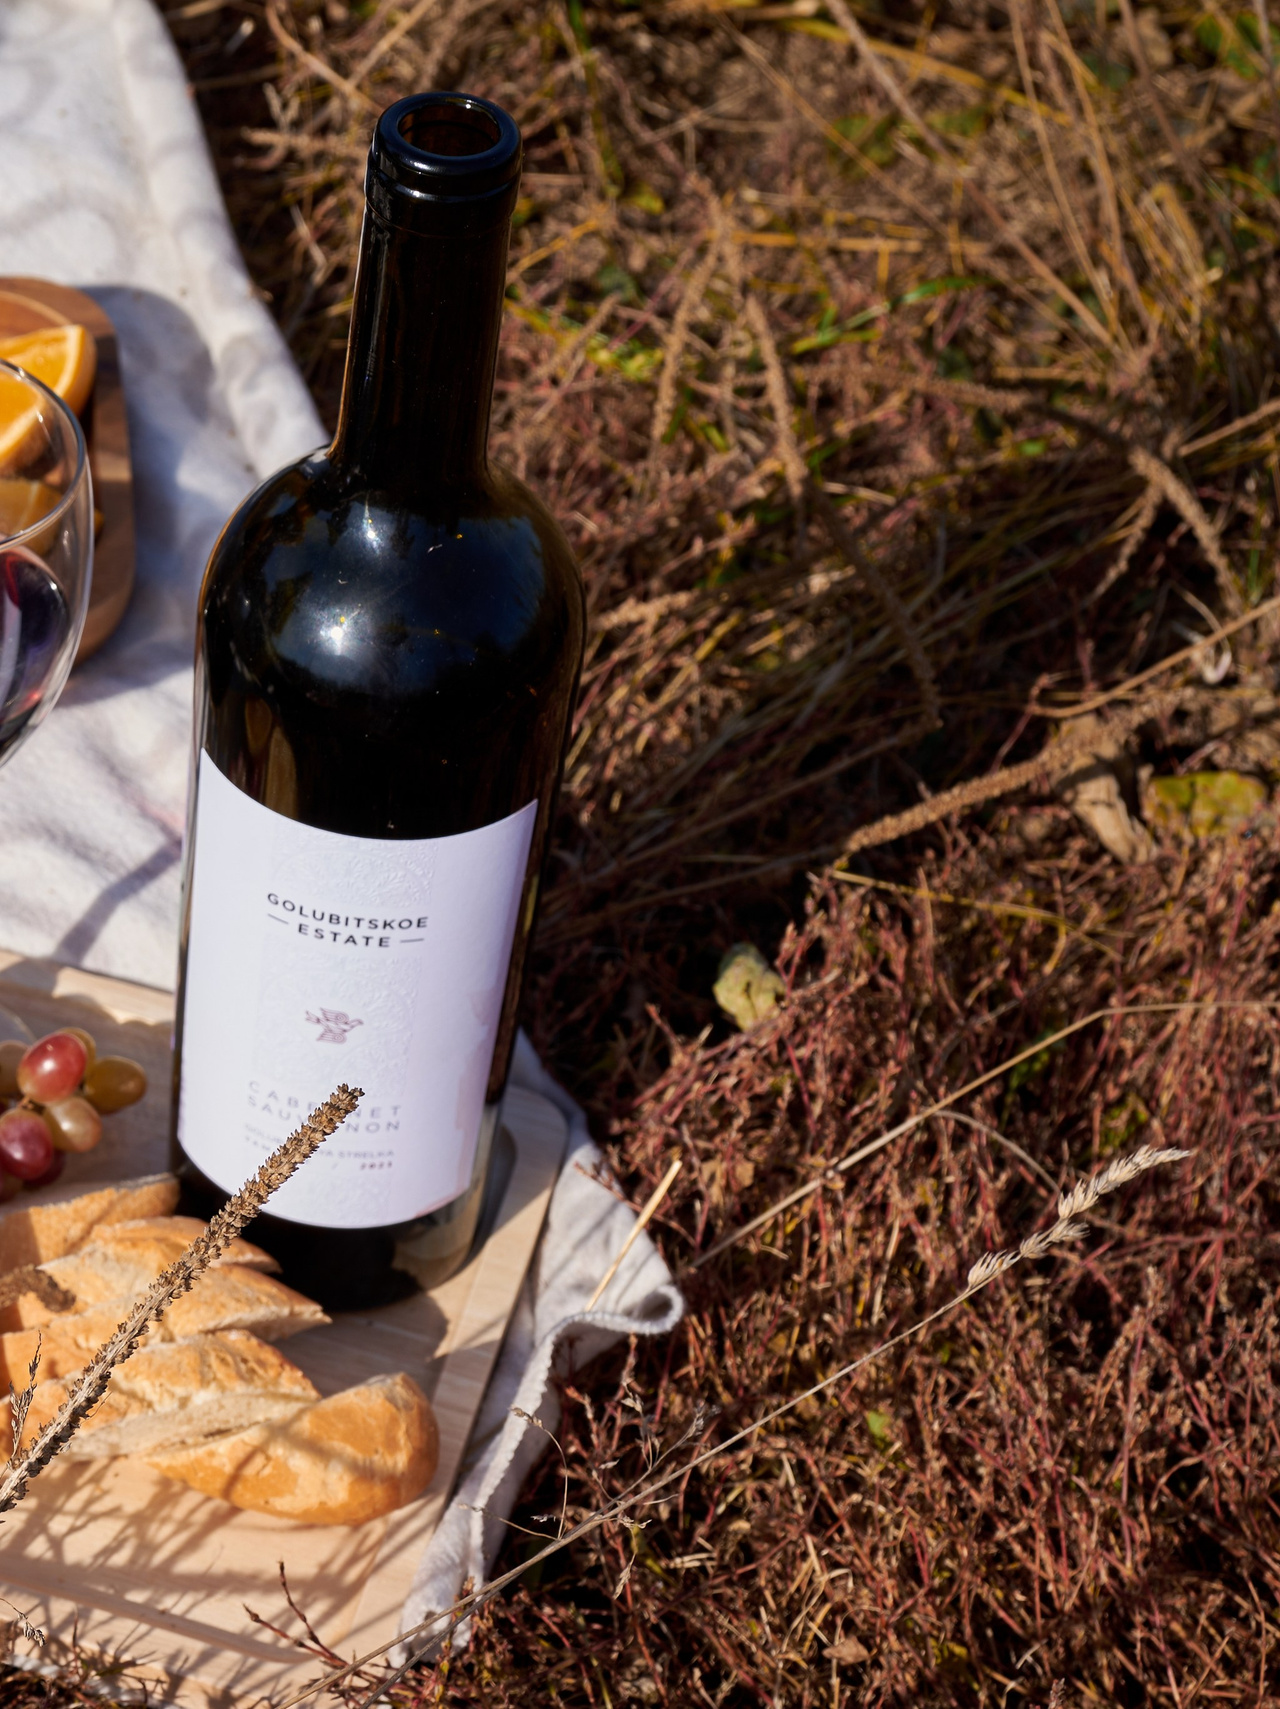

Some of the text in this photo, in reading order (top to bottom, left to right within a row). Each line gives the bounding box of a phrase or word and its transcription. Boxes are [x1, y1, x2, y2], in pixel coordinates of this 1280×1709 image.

[267, 893, 428, 930] GOLUBITSKOE
[298, 923, 391, 948] ESTATE
[248, 1095, 400, 1133] SAUVNON
[249, 1081, 401, 1118] CABENET
